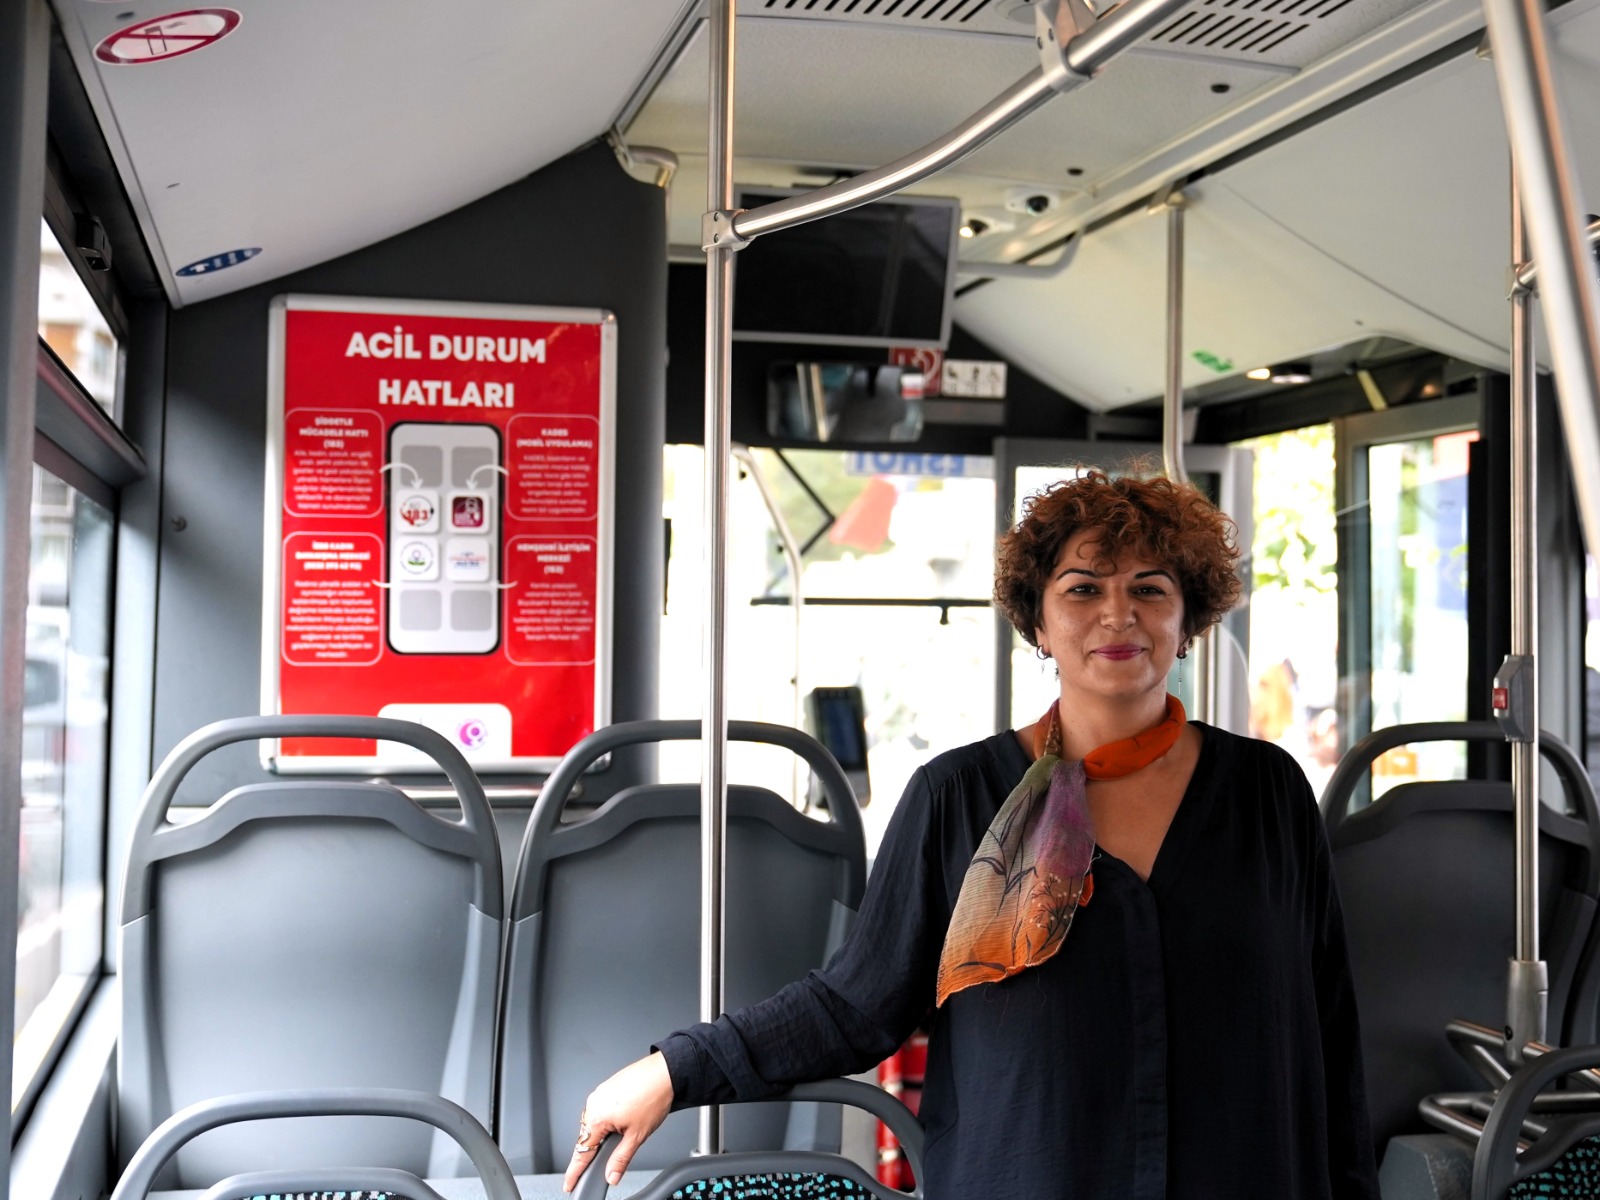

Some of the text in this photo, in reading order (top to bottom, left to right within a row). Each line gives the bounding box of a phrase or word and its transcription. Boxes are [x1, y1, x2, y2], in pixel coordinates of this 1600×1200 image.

[345, 325, 546, 364] ACİL DURUM
[378, 378, 514, 408] HATLARI
